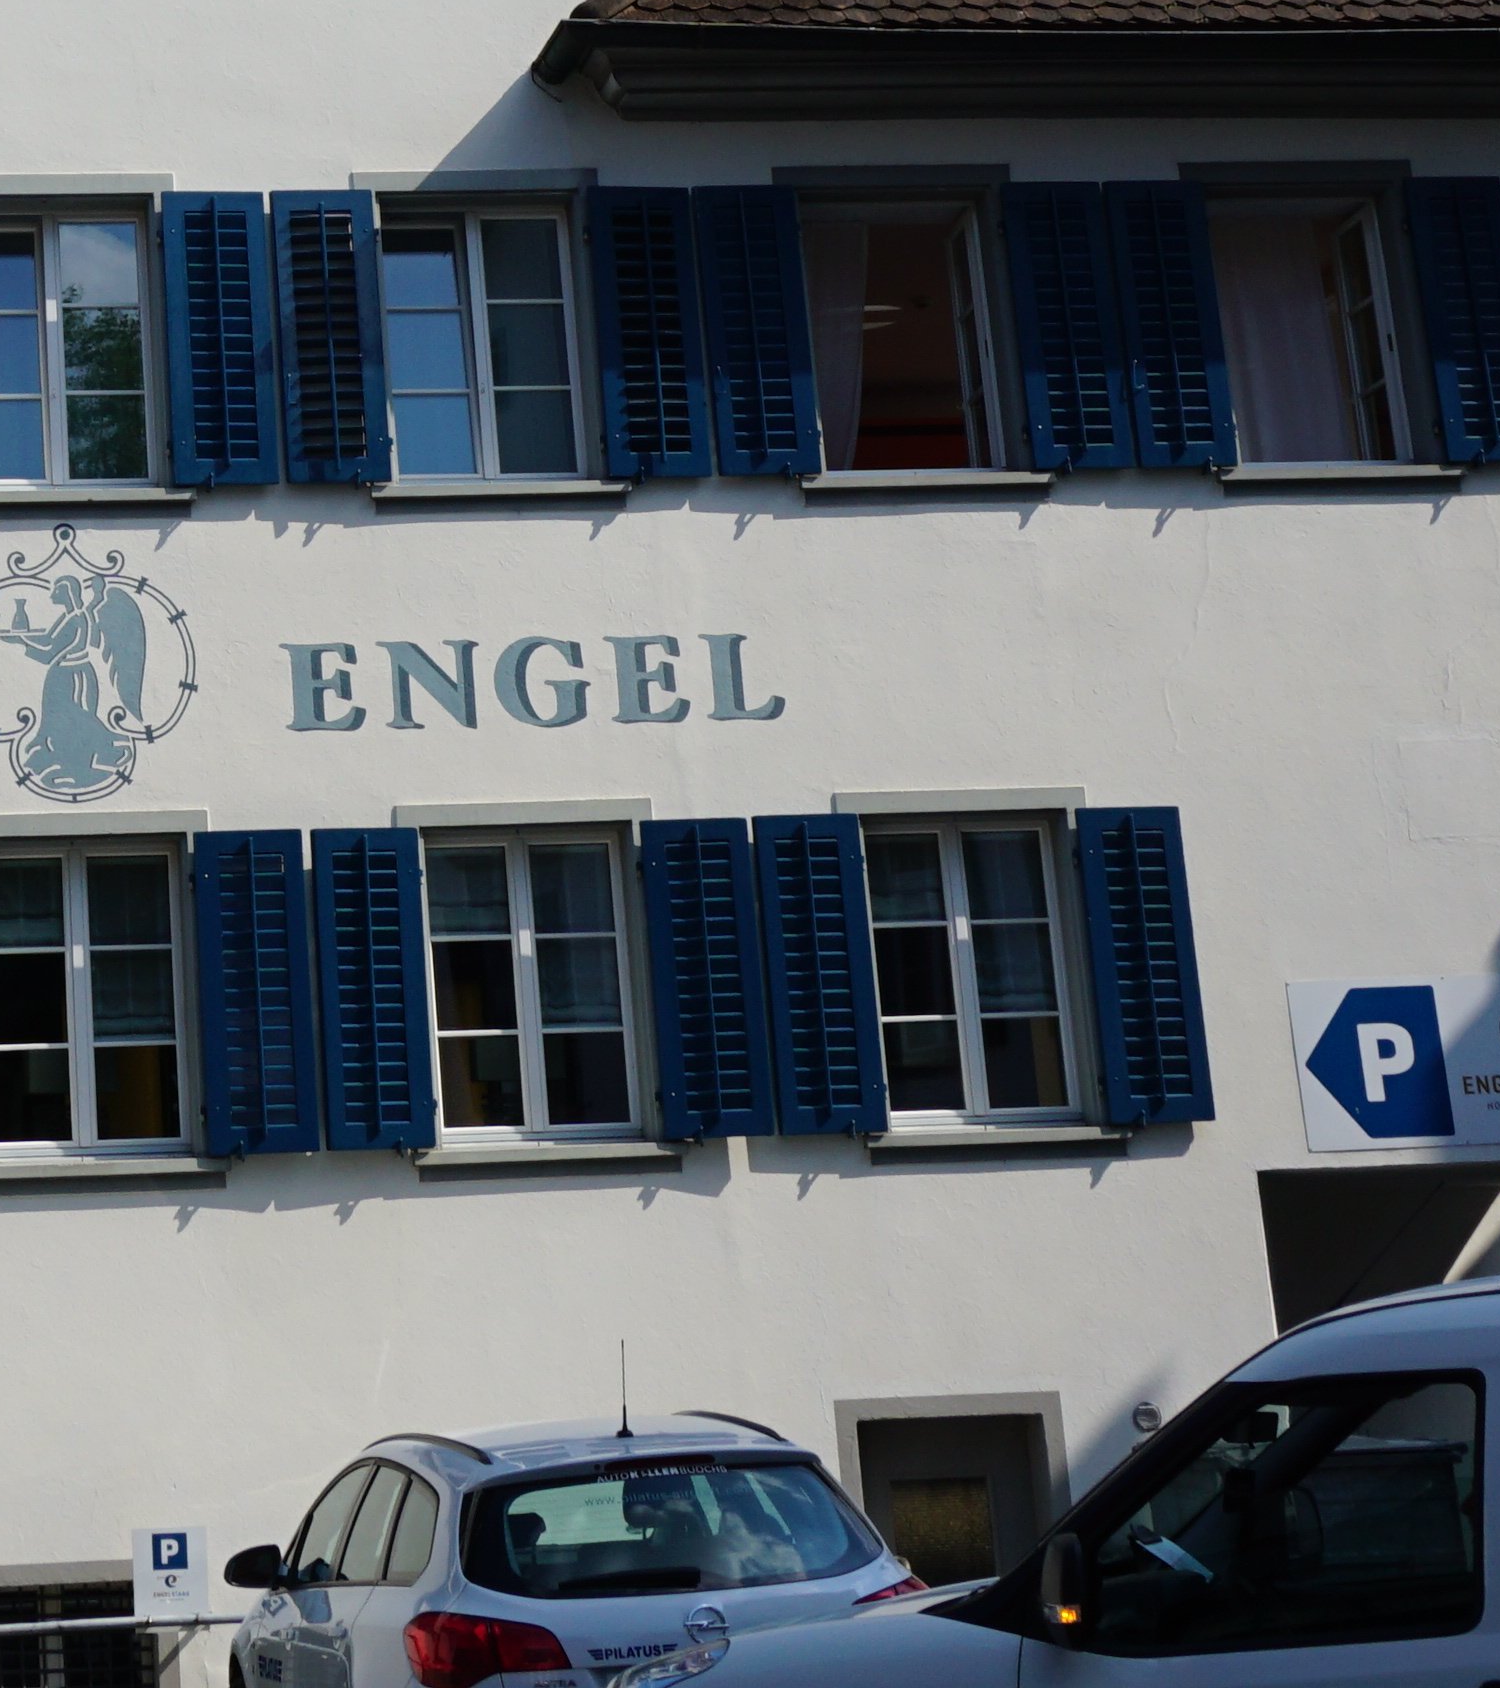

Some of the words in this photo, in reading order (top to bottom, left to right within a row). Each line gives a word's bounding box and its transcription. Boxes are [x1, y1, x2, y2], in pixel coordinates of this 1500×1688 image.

[278, 633, 786, 732] ENGEL
[1356, 1022, 1415, 1102] P
[160, 1538, 179, 1565] P
[604, 1644, 662, 1660] PILATUS
